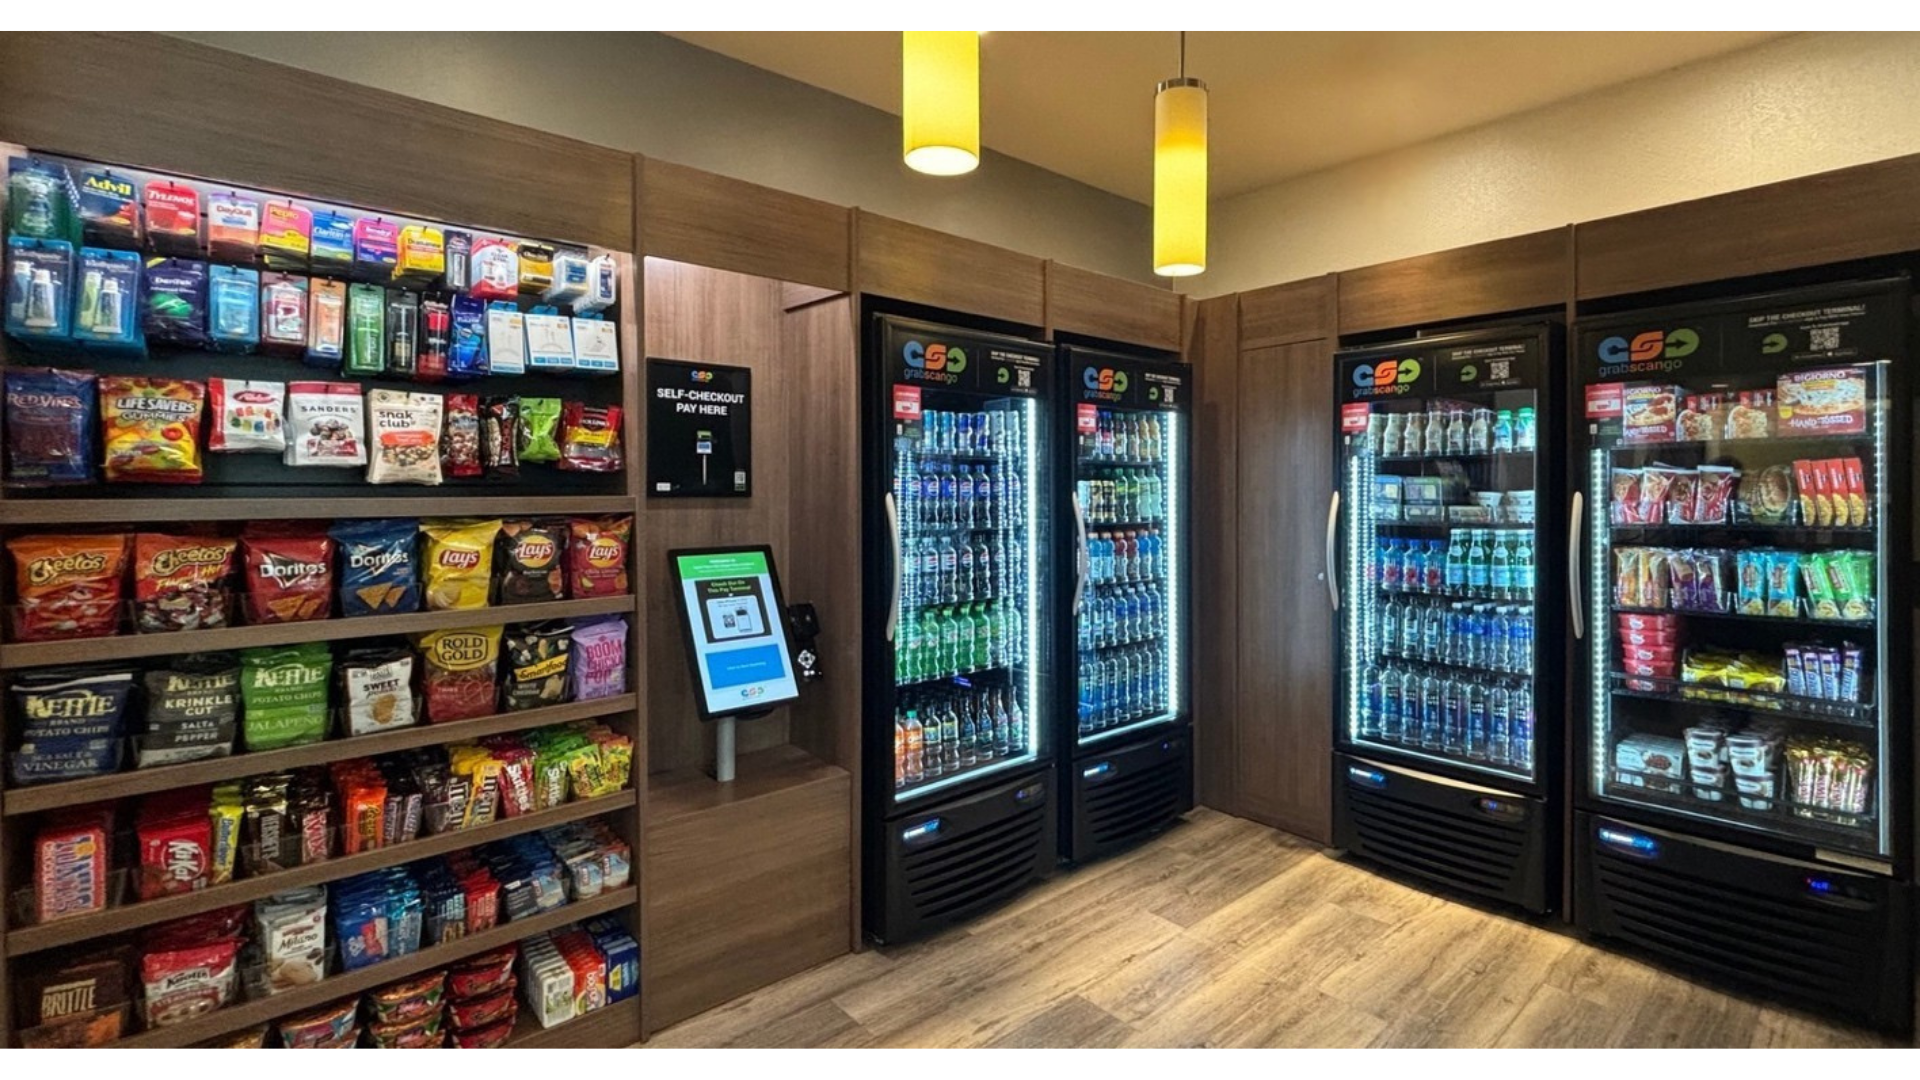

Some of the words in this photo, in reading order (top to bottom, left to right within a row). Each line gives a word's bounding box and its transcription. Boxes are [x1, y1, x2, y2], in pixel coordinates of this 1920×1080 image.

[87, 177, 132, 196] Advil
[216, 205, 253, 217] DayQuil
[904, 368, 958, 384] grabscango
[1598, 360, 1683, 378] grabscango
[656, 388, 745, 404] SELF-CHECKOUT
[1353, 384, 1410, 398] grabscango
[379, 411, 413, 419] snak
[676, 403, 697, 413] PAY
[699, 404, 728, 415] HERE
[380, 419, 410, 428] club
[154, 547, 226, 577] Cheetos
[259, 559, 327, 578] Doritos
[350, 551, 410, 570] Doritos
[29, 552, 108, 586] Cheetos
[442, 635, 483, 650] ROLD
[441, 647, 484, 662] GOLD
[586, 641, 623, 661] BOOM
[254, 666, 325, 688] KETTLE
[363, 679, 401, 692] SWEET
[26, 693, 118, 719] KETTLE
[165, 694, 233, 709] KRINKLE
[185, 705, 213, 716] CUT
[175, 732, 218, 742] PEPPER
[23, 759, 100, 771] VINEGAR
[506, 763, 532, 811] Skittles
[278, 933, 318, 952] Milano
[42, 986, 97, 1018] BRITTLE
